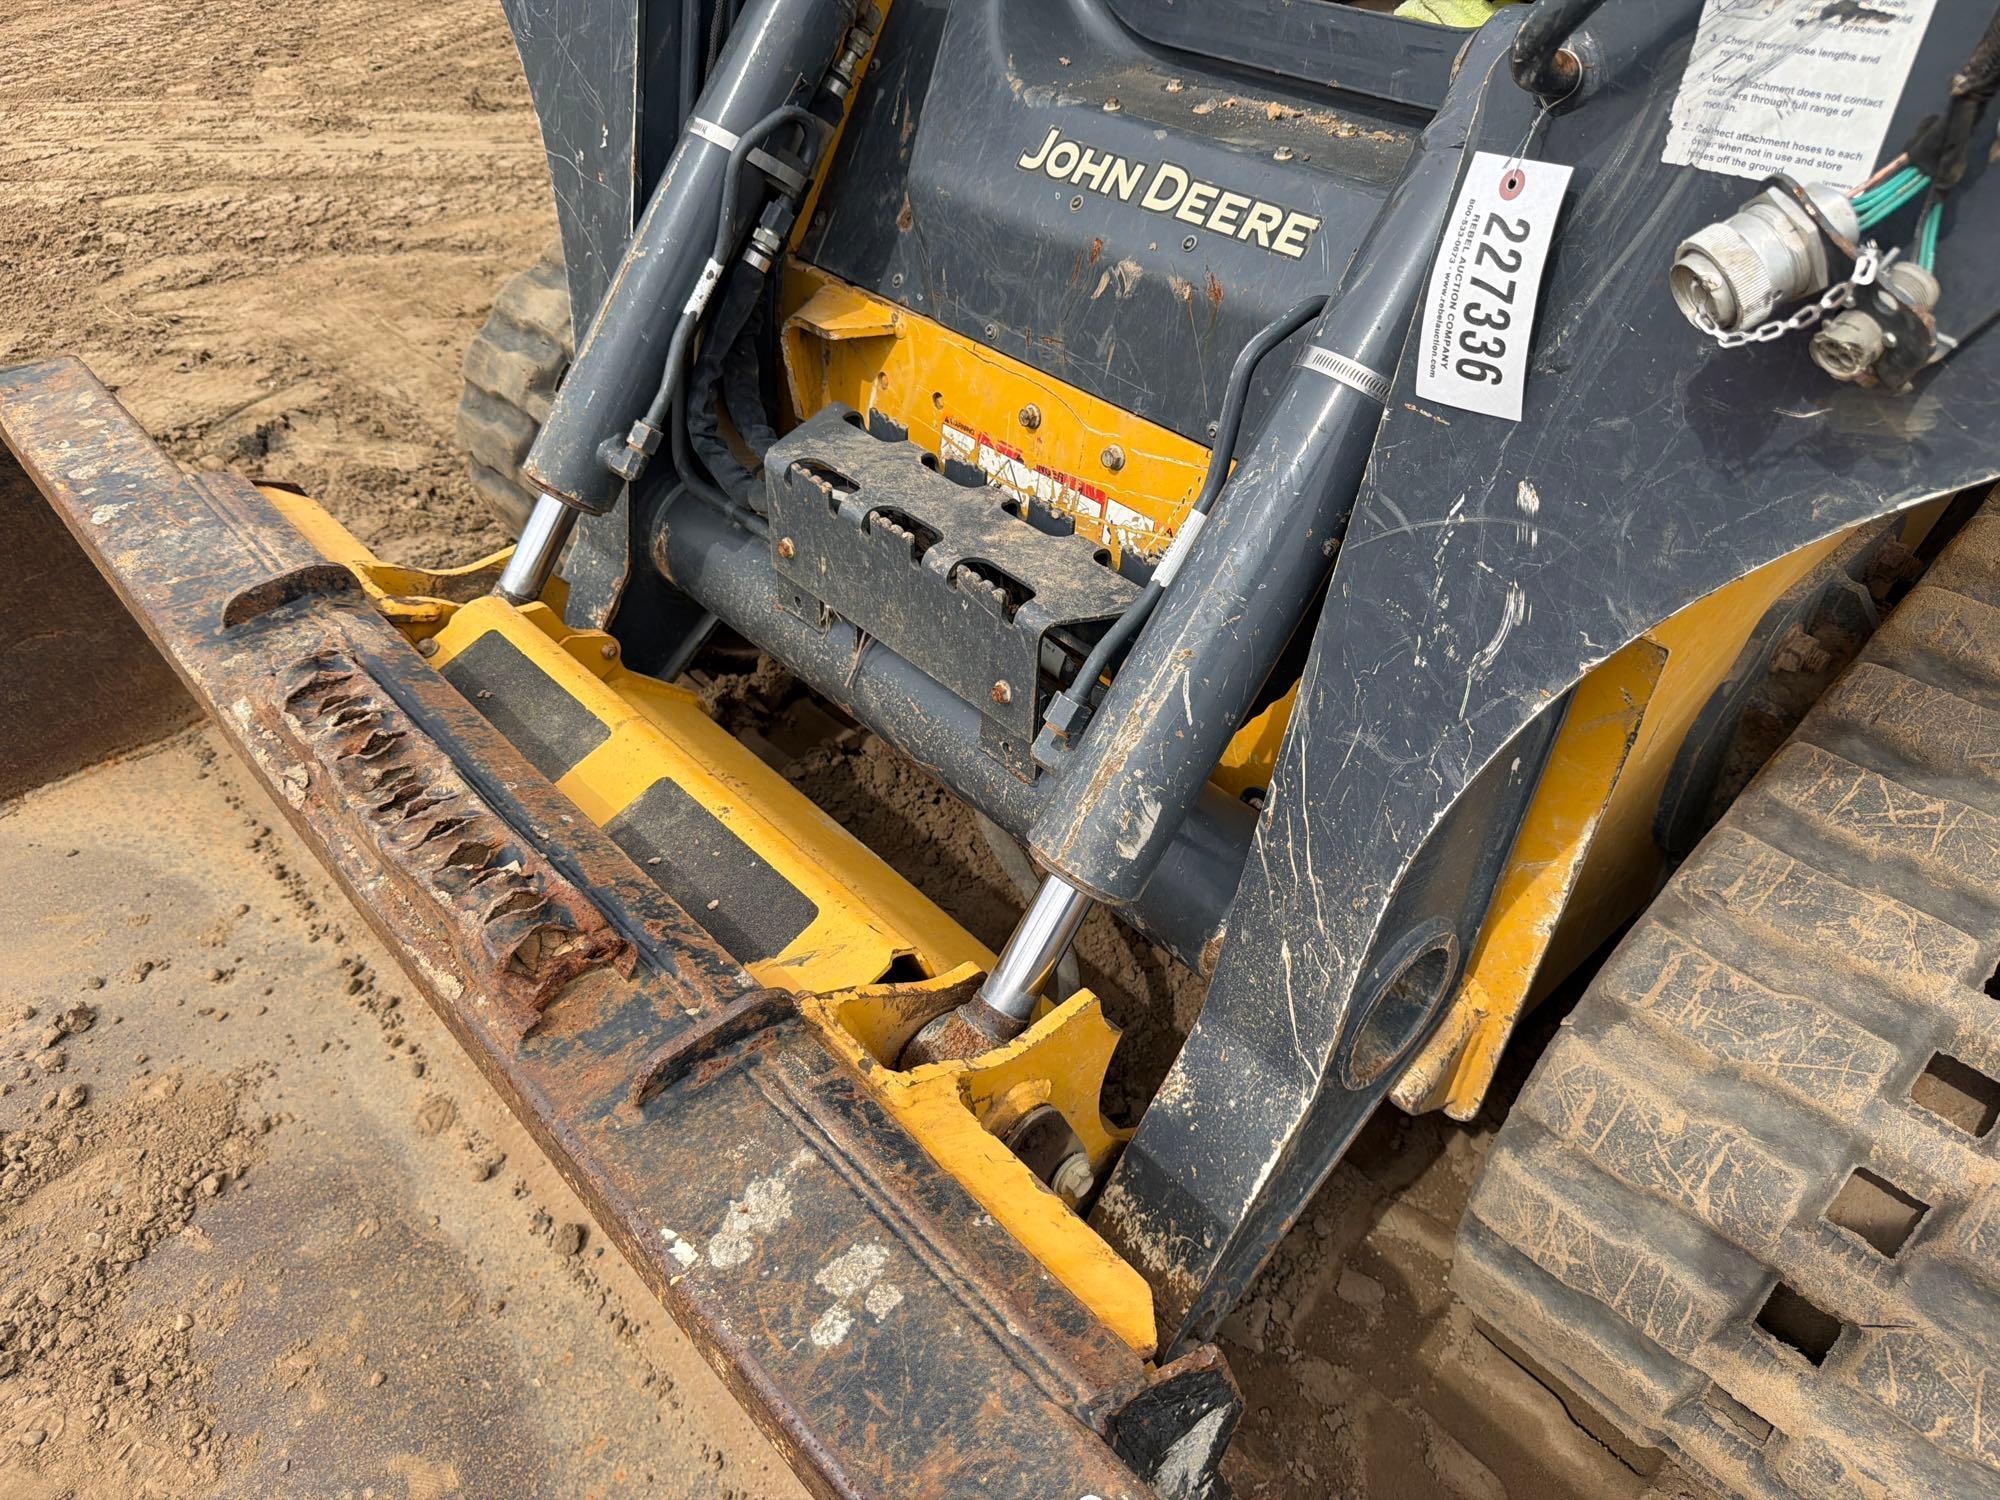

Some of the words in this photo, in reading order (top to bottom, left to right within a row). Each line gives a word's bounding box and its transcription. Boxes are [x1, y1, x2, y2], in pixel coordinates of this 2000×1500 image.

[1819, 47, 1857, 62] lengths
[1860, 55, 1881, 64] and
[1743, 79, 1795, 94] ttachment
[1797, 88, 1822, 99] does
[1824, 93, 1842, 103] not
[1844, 96, 1884, 109] contact
[1751, 94, 1789, 109] through
[1792, 101, 1808, 111] full
[1809, 104, 1839, 117] range
[1841, 108, 1854, 117] of
[1716, 154, 1730, 164] off
[1731, 157, 1747, 168] the
[1717, 142, 1742, 155] when
[1744, 148, 1761, 158] not
[1763, 149, 1772, 159] in
[1775, 153, 1793, 163] use
[1795, 156, 1815, 167] and
[1816, 160, 1843, 172] store
[1736, 132, 1791, 149] attachment
[1792, 141, 1823, 155] hoses
[1825, 147, 1836, 157] to
[1838, 150, 1863, 161] each
[1018, 128, 1146, 201] JOHN
[1140, 162, 1321, 258] DEERE
[1449, 198, 1476, 264] 800-533-0673
[1462, 214, 1481, 252] REBEL
[1448, 256, 1467, 310] AUCTION
[1455, 212, 1531, 386] 227336
[1429, 272, 1451, 378] www.rebelauction.com
[1441, 313, 1455, 370] COMPANY
